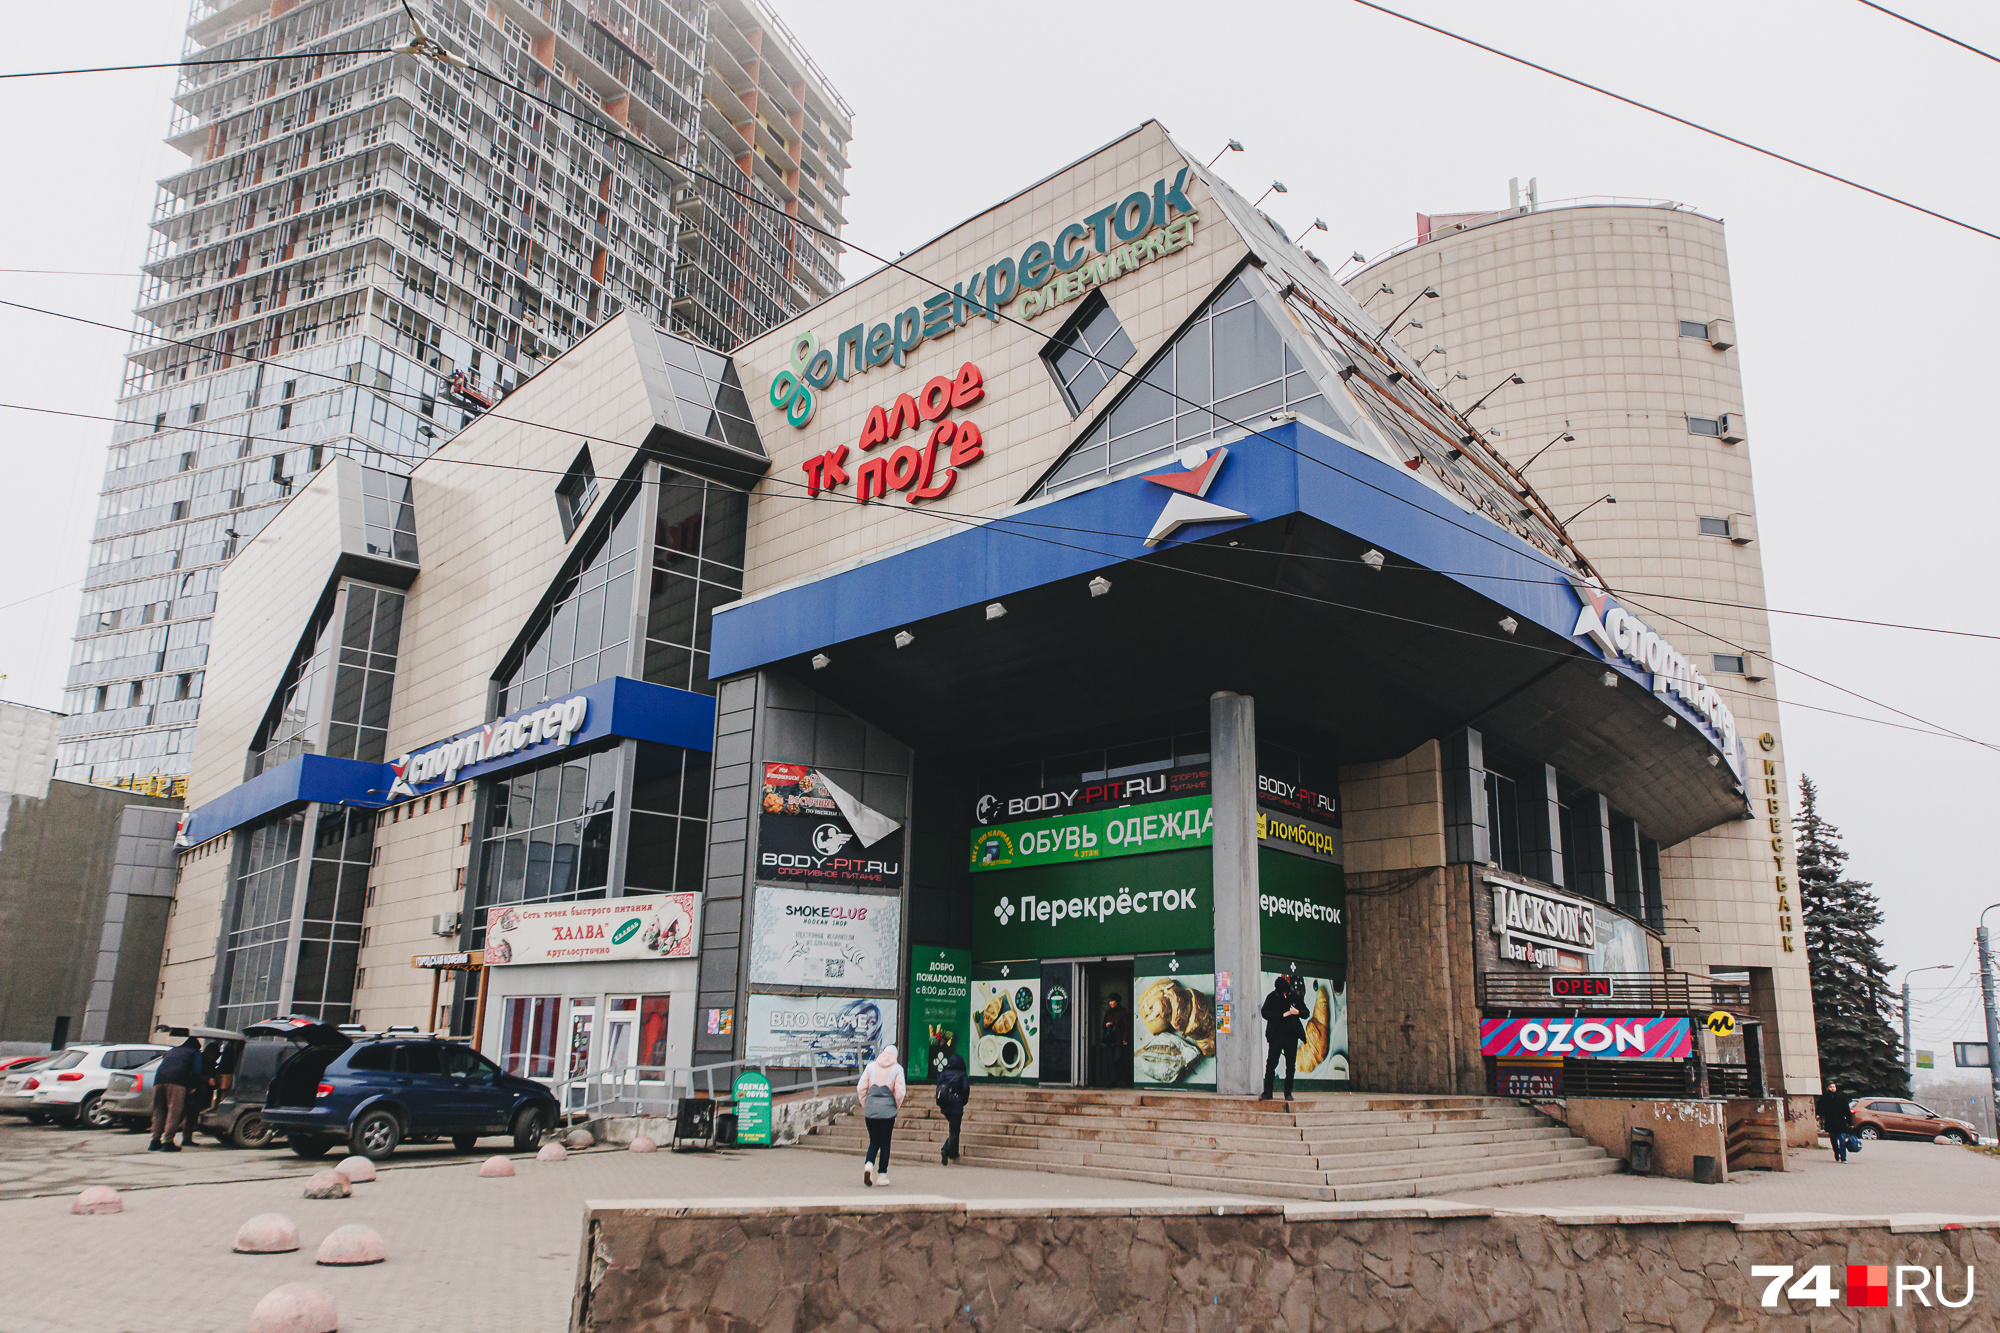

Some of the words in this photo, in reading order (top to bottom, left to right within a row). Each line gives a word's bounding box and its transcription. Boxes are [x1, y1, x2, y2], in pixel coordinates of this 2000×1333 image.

[1016, 214, 1199, 321] СУПЕРМАРКЕТ
[802, 444, 850, 498] ТК
[1170, 770, 1213, 783] СПОРТИВН
[1007, 773, 1167, 816] BODY-PIT.RU
[1170, 780, 1207, 793] ПИТАНИЕ
[1258, 774, 1337, 812] BODY-PIT.RU
[1019, 824, 1098, 856] ОБУВЬ
[1269, 819, 1334, 856] ломбард
[1073, 850, 1079, 858] 4
[1763, 759, 1796, 953] ИНВЕСТБАНК
[762, 853, 899, 875] BODY-PIT.RU
[778, 867, 838, 879] СПОРТИВНОЕ
[841, 871, 882, 882] ПИТАНИЕ
[522, 908, 541, 920] Сеть
[544, 907, 568, 919] точек
[570, 905, 612, 918] быстрого
[614, 903, 653, 914] питания
[1020, 886, 1197, 927] Перекрёсток
[1259, 890, 1342, 925] ерекрёсток
[1492, 886, 1594, 947] JACKSON'S
[546, 945, 610, 957] круглосуточно
[929, 961, 955, 972] ДОБРО
[916, 972, 967, 985] ПОЖАЛОВАТЬ!
[1555, 979, 1609, 996] OPEN
[921, 985, 938, 995] 8:00
[937, 988, 947, 997] до
[947, 986, 967, 997] 23:00
[770, 1010, 809, 1028] BRO
[812, 1011, 869, 1029] GAME
[1518, 1022, 1646, 1053] OZON
[737, 1082, 769, 1091] ОДЕЖДА
[746, 1090, 769, 1099] ОБУВЬ
